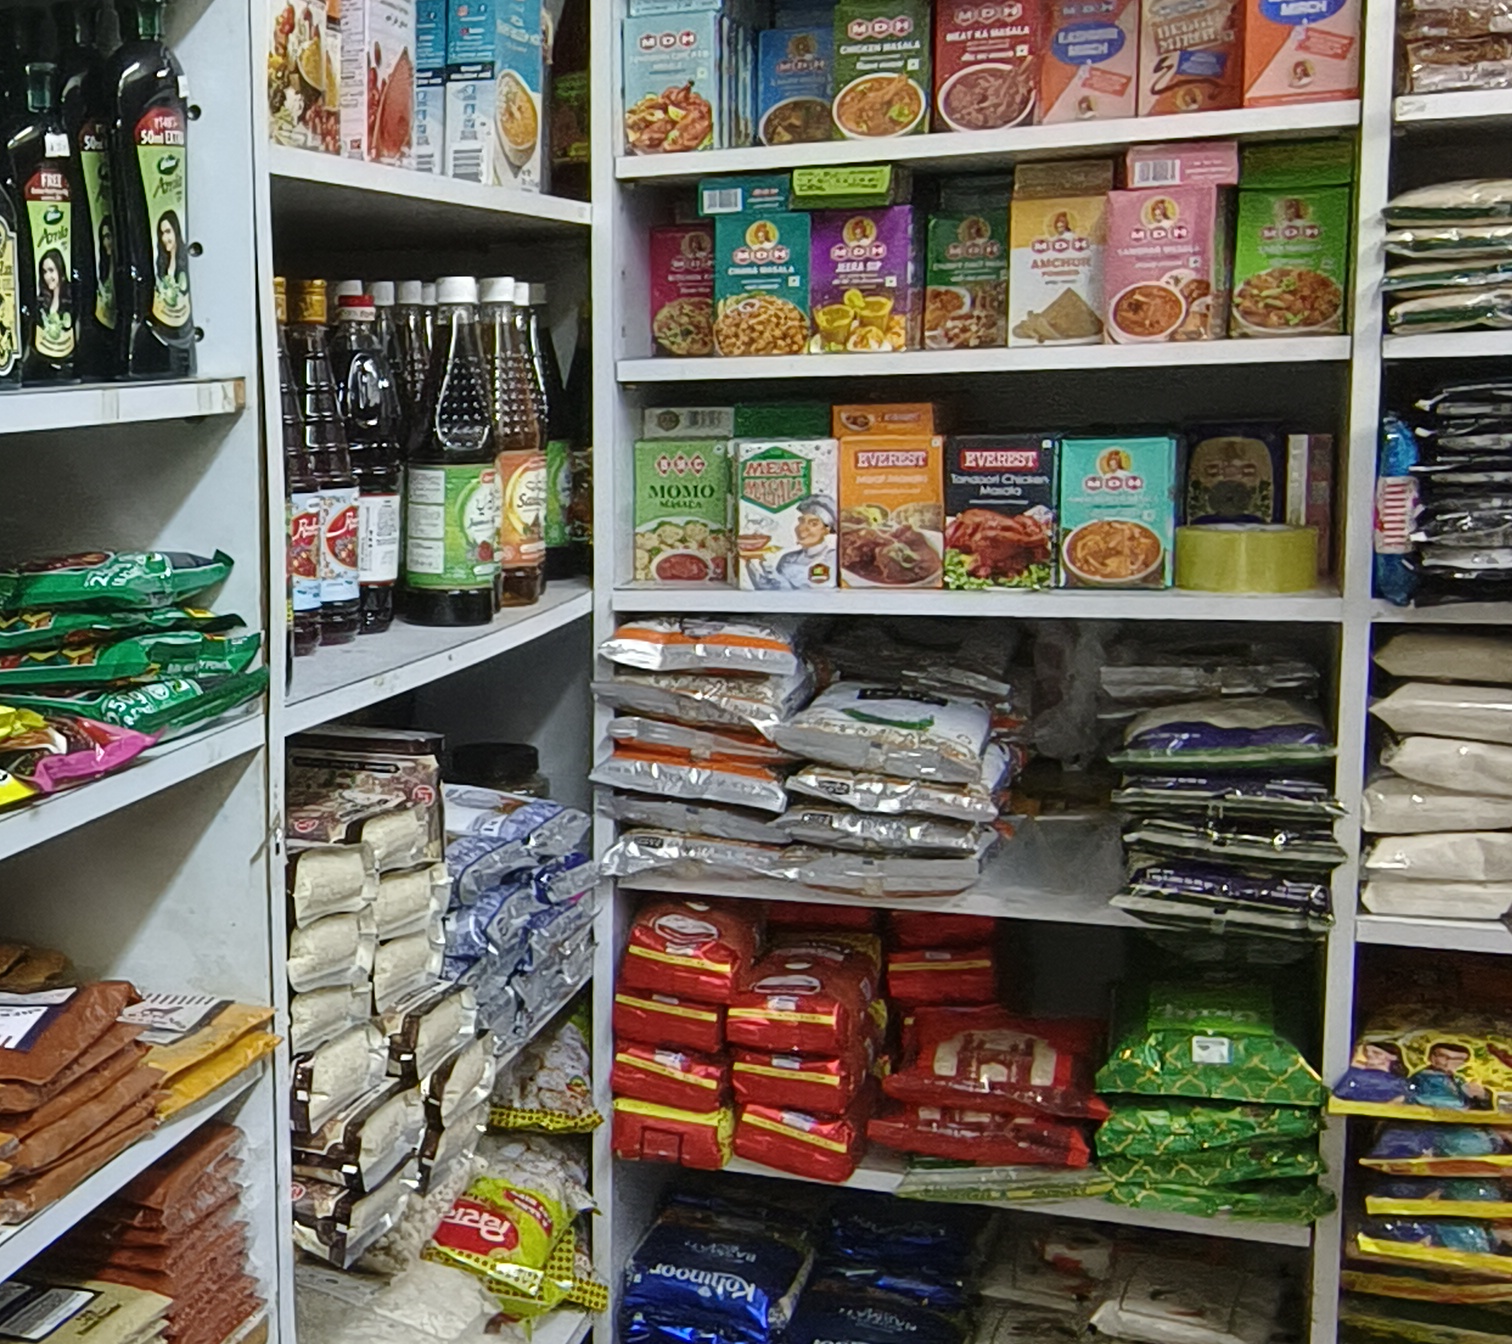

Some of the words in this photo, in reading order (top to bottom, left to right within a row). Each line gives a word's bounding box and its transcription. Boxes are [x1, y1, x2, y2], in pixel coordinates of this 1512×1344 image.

[955, 3, 1023, 26] MDH
[1280, 0, 1327, 16] MIRCH
[847, 15, 913, 40] MDH
[639, 31, 696, 50] MDH
[41, 173, 62, 188] FREE
[1129, 226, 1188, 242] MDH
[830, 243, 887, 260] MDH
[1030, 238, 1088, 254] MDH
[733, 246, 790, 264] MDH
[857, 451, 928, 467] EVEREST
[963, 451, 1038, 468] EVEREST
[745, 461, 803, 477] MEAT
[648, 484, 715, 499] MOMO
[1083, 477, 1144, 491] MDH
[648, 1262, 757, 1303] Kohinoor
